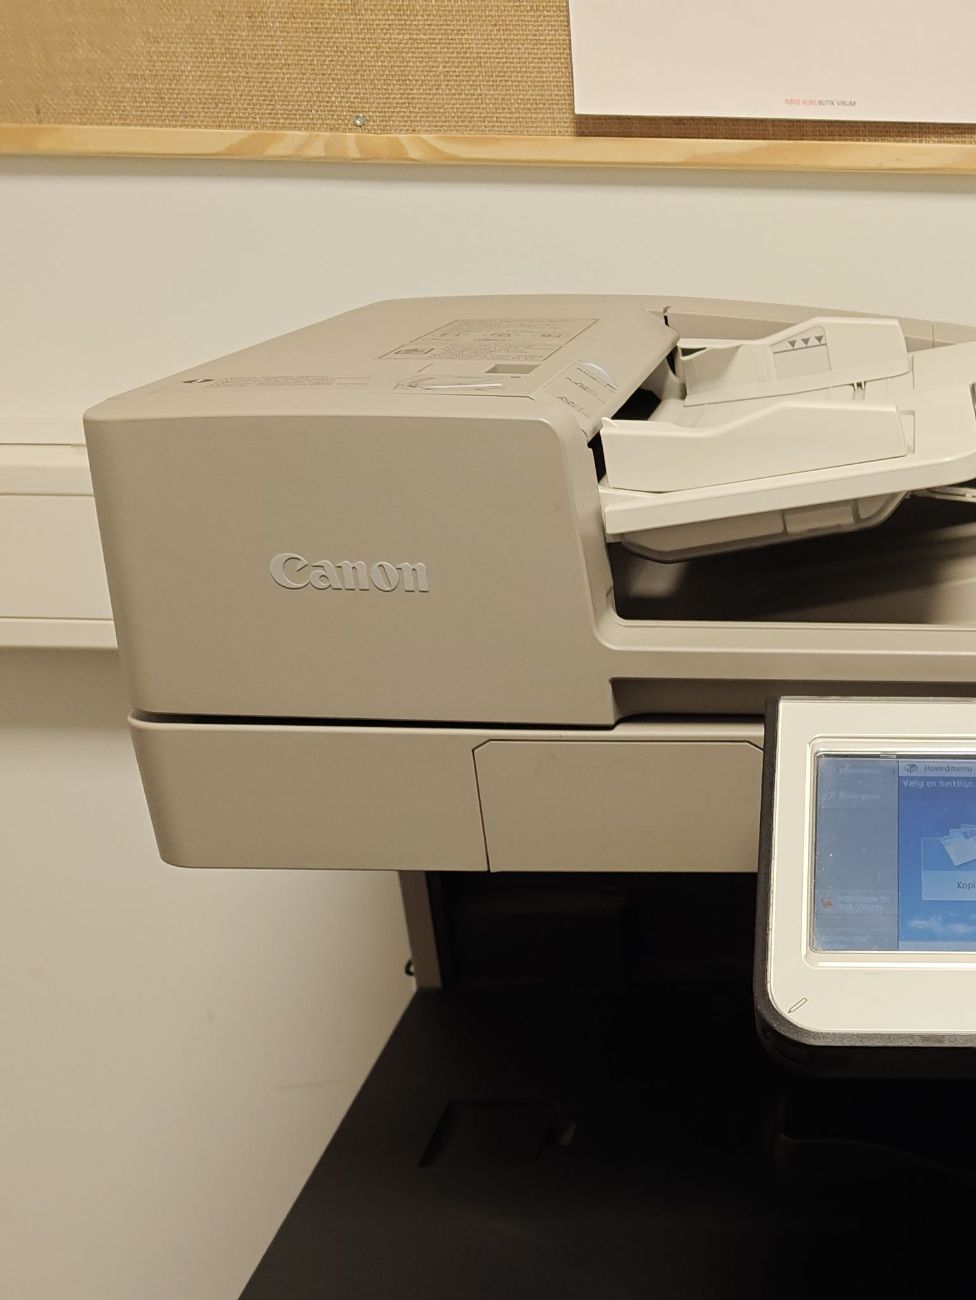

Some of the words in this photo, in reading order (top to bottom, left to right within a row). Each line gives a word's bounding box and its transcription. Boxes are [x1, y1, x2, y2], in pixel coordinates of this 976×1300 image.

[269, 552, 430, 593] Canon
[903, 780, 924, 789] Vælg
[956, 880, 976, 891] Kopi
